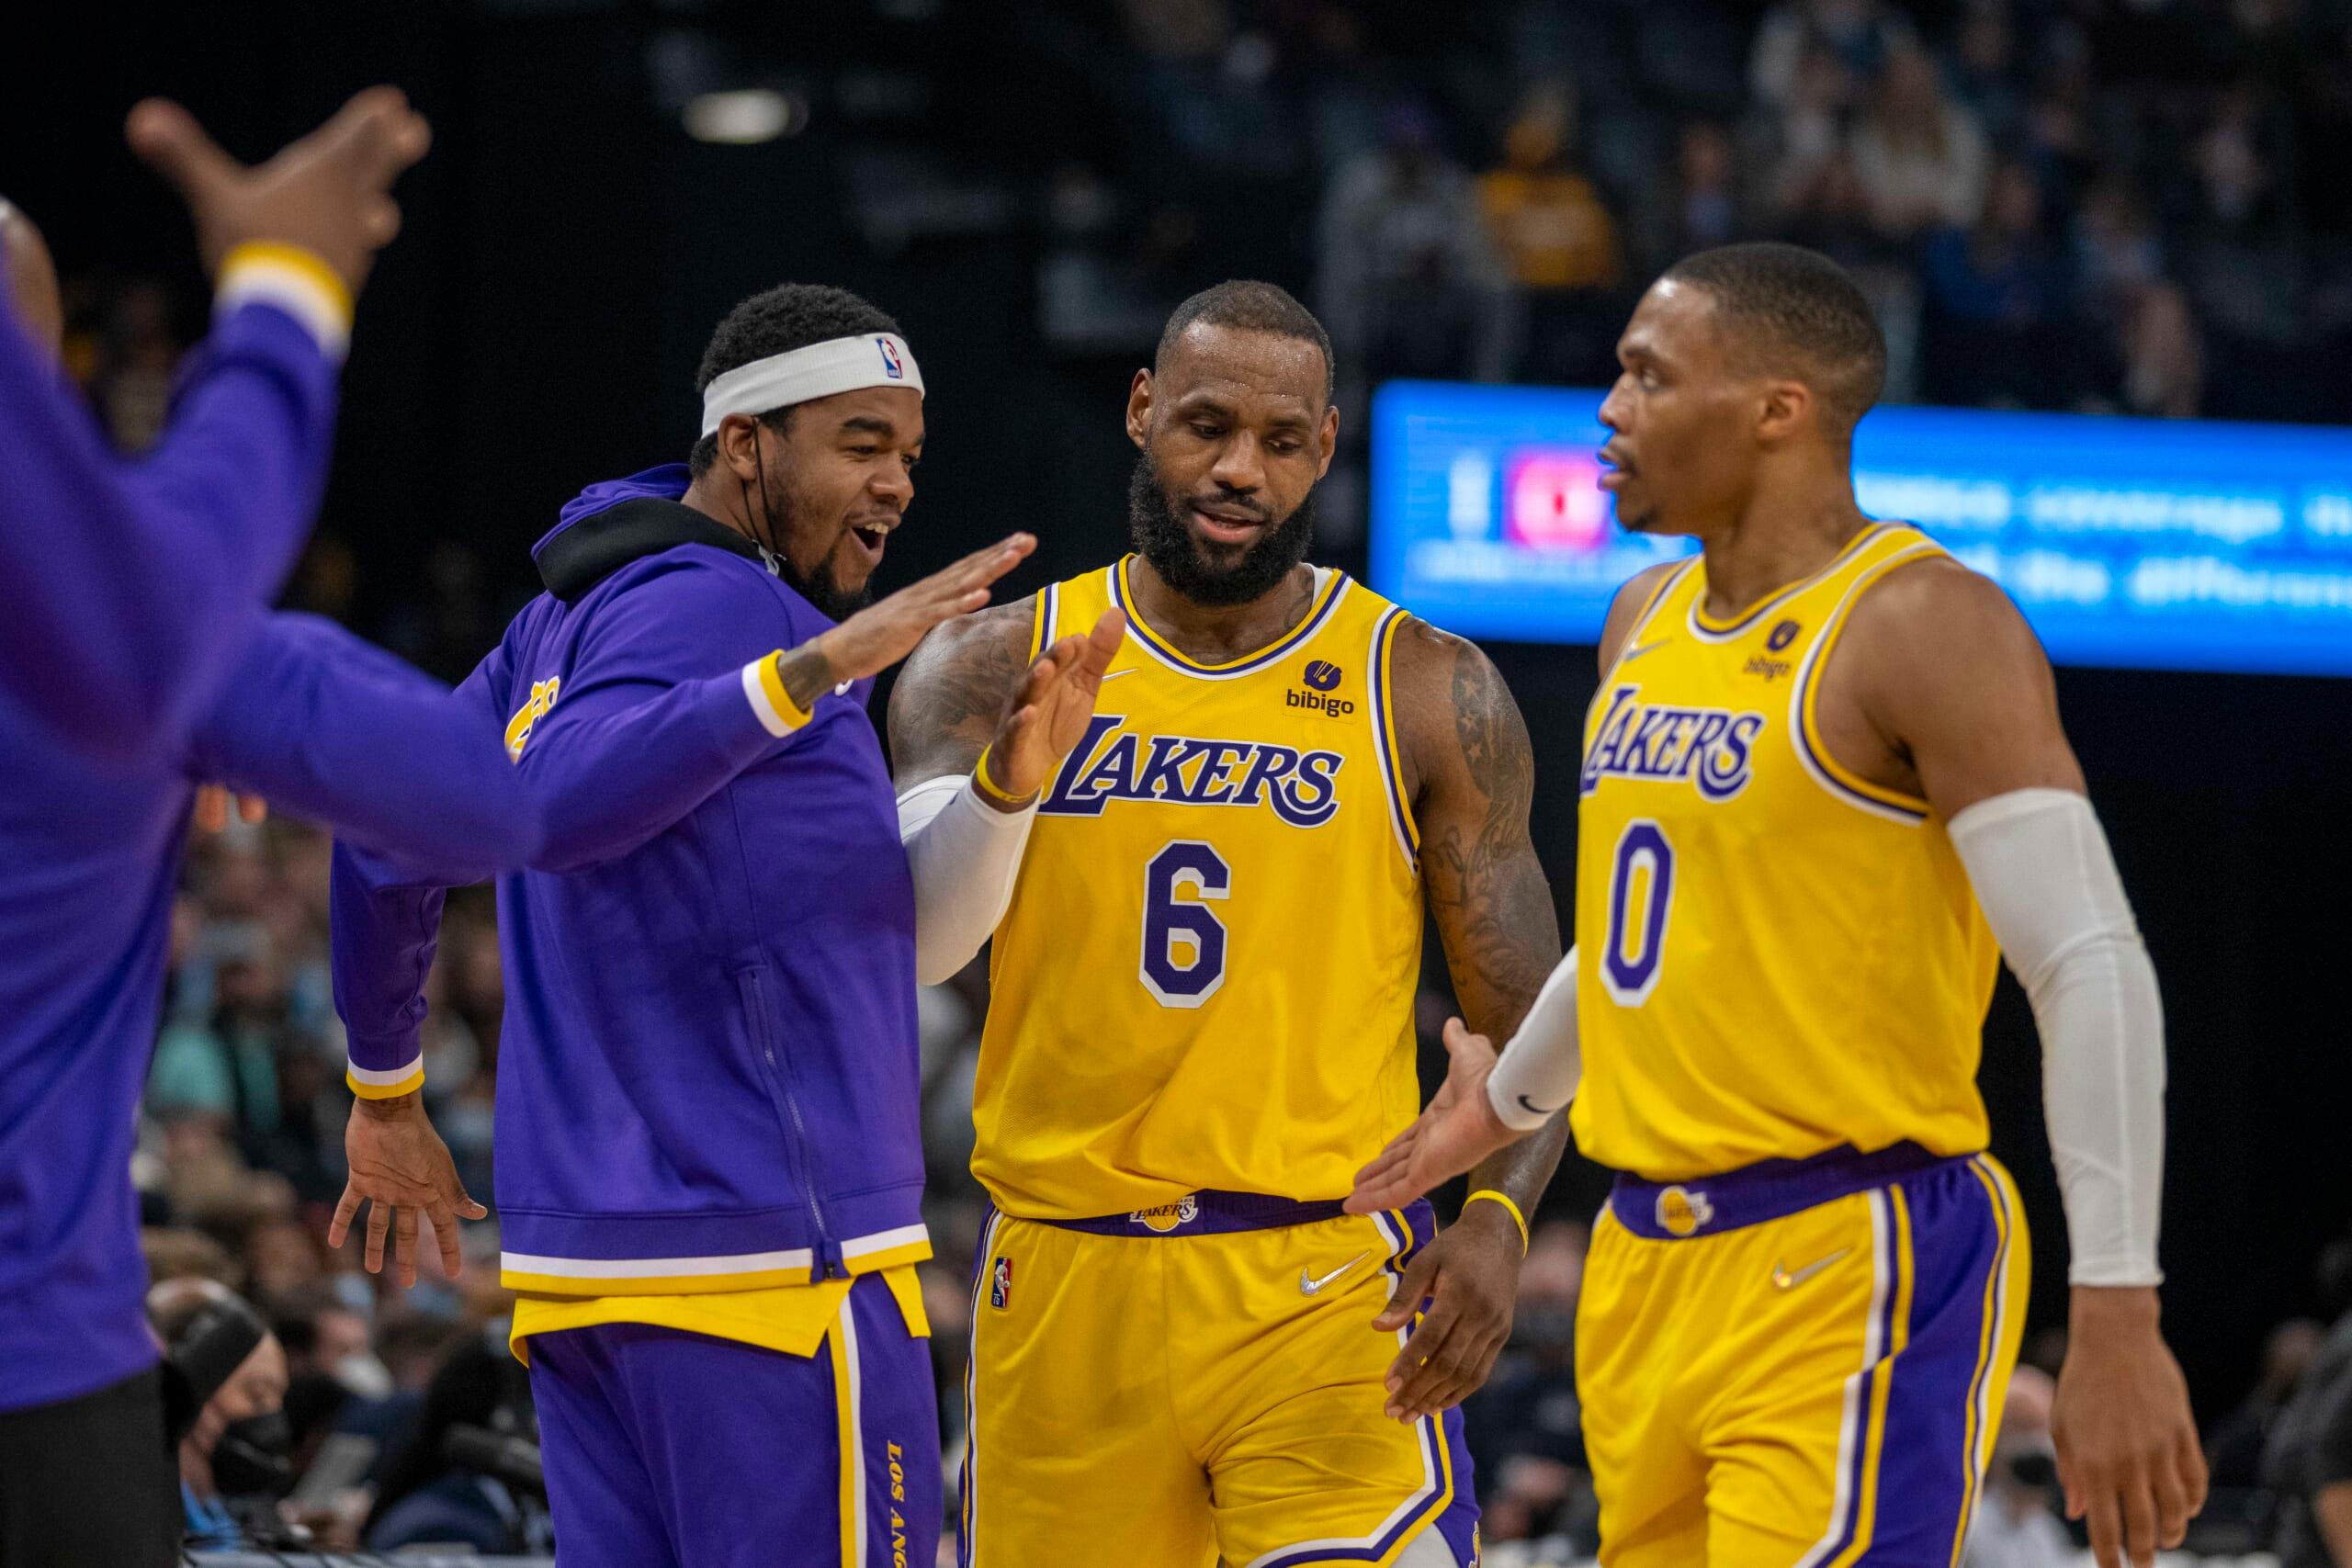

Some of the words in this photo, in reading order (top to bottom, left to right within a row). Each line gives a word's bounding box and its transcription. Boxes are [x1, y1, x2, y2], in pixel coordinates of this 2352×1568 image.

[1286, 688, 1354, 718] bibigo
[1580, 683, 1766, 803] LAKERS
[1036, 714, 1346, 829] LAKERS
[1139, 840, 1231, 1009] 6
[1600, 818, 1677, 1008] 0
[1130, 1202, 1195, 1221] LAKERS
[888, 1439, 905, 1503] LOS
